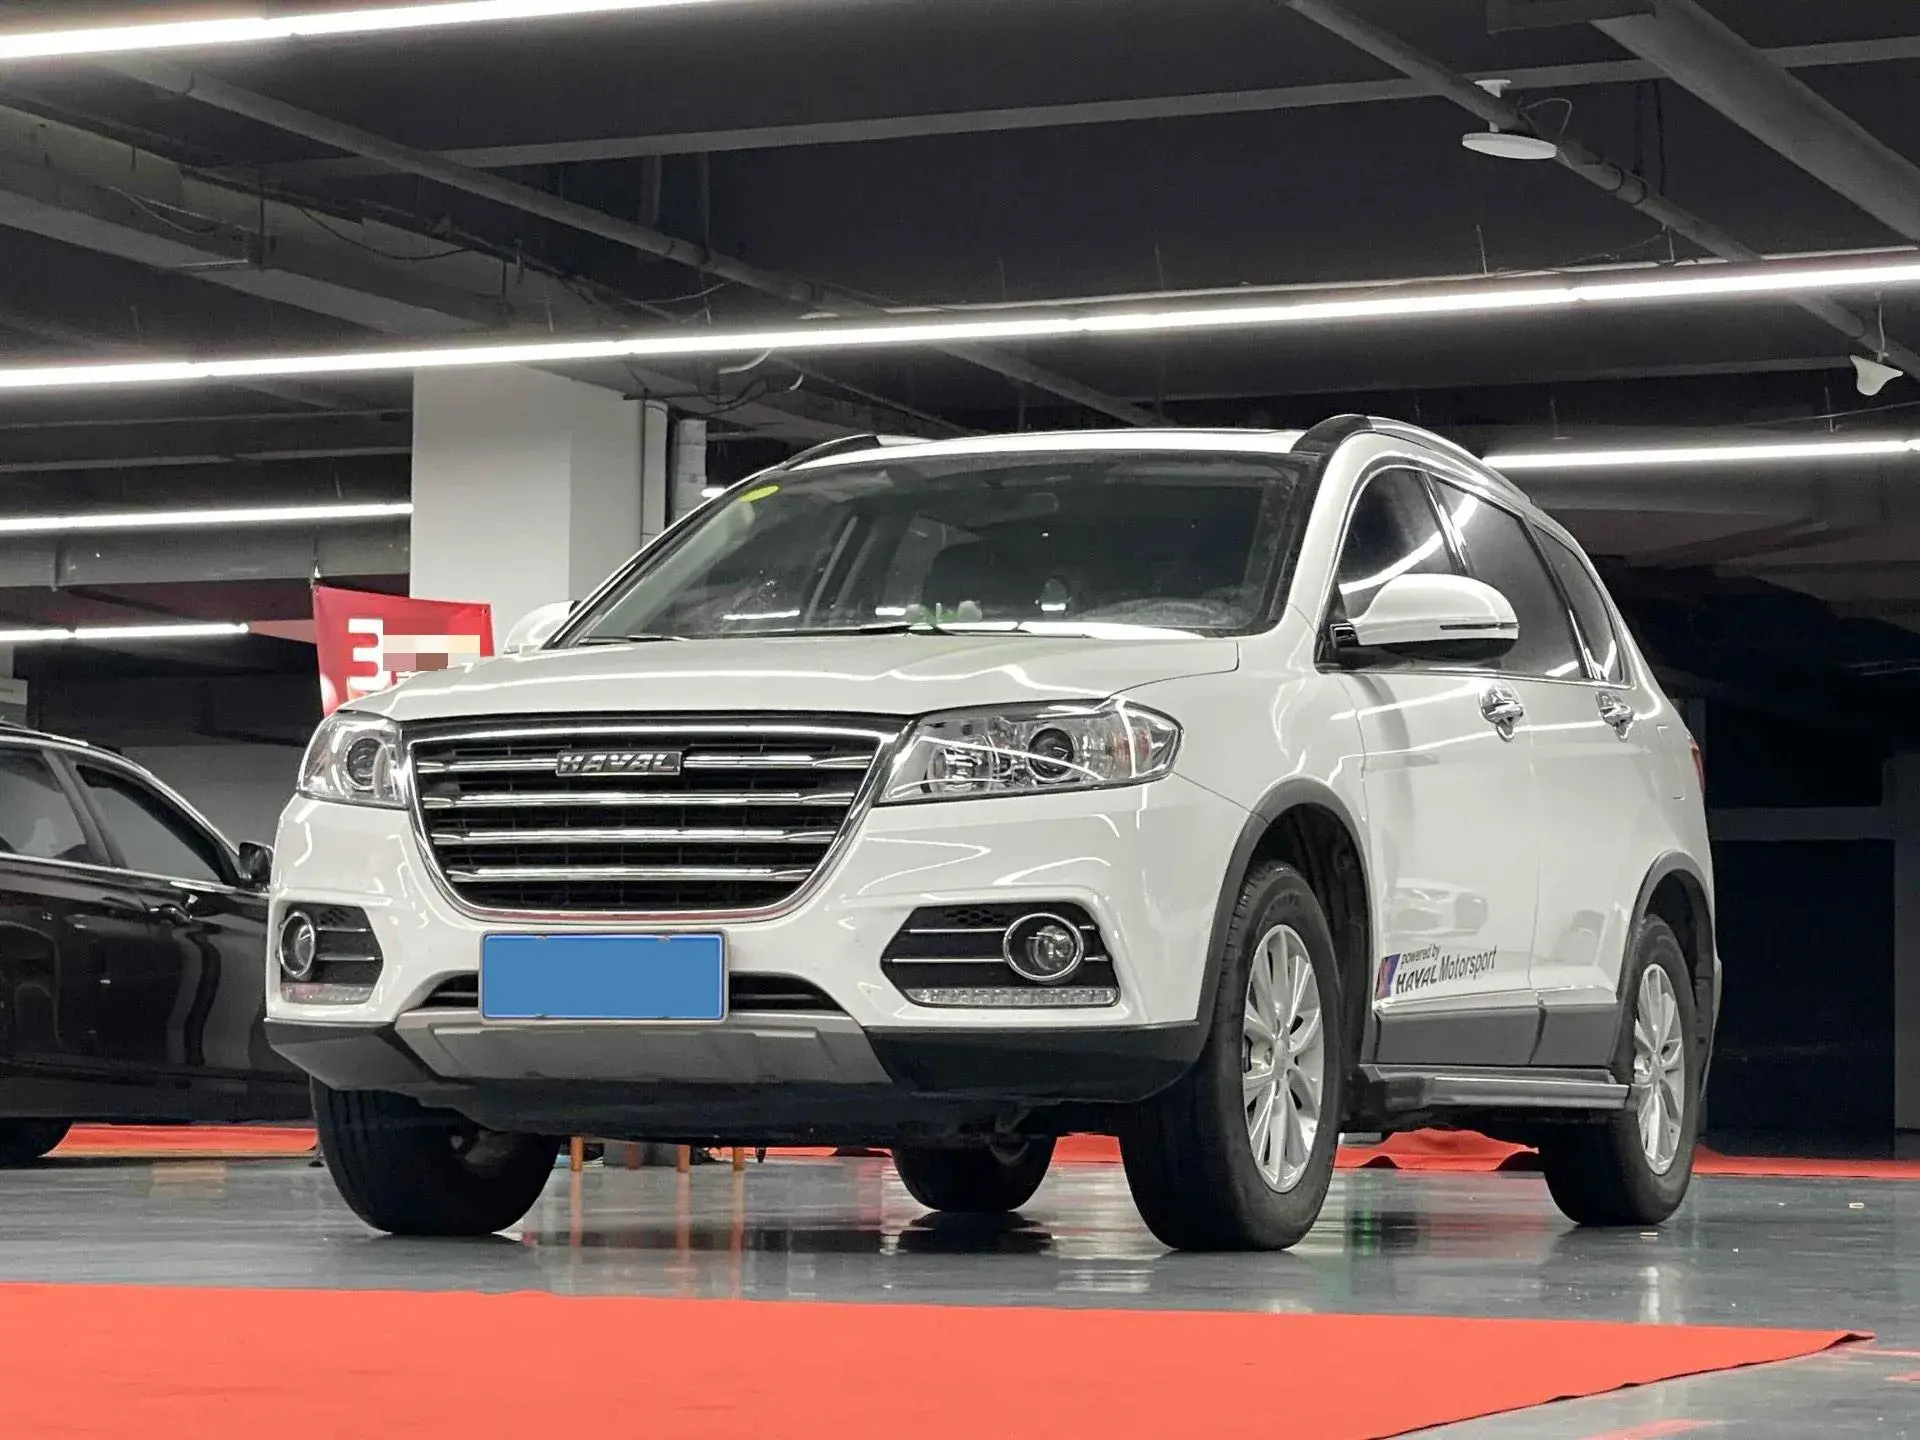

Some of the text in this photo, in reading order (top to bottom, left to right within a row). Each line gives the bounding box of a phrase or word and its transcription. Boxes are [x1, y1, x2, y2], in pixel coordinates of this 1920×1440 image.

[560, 753, 676, 773] HAVAL
[1400, 943, 1441, 968] powered by
[1395, 944, 1497, 995] HAVAL Motorsport
